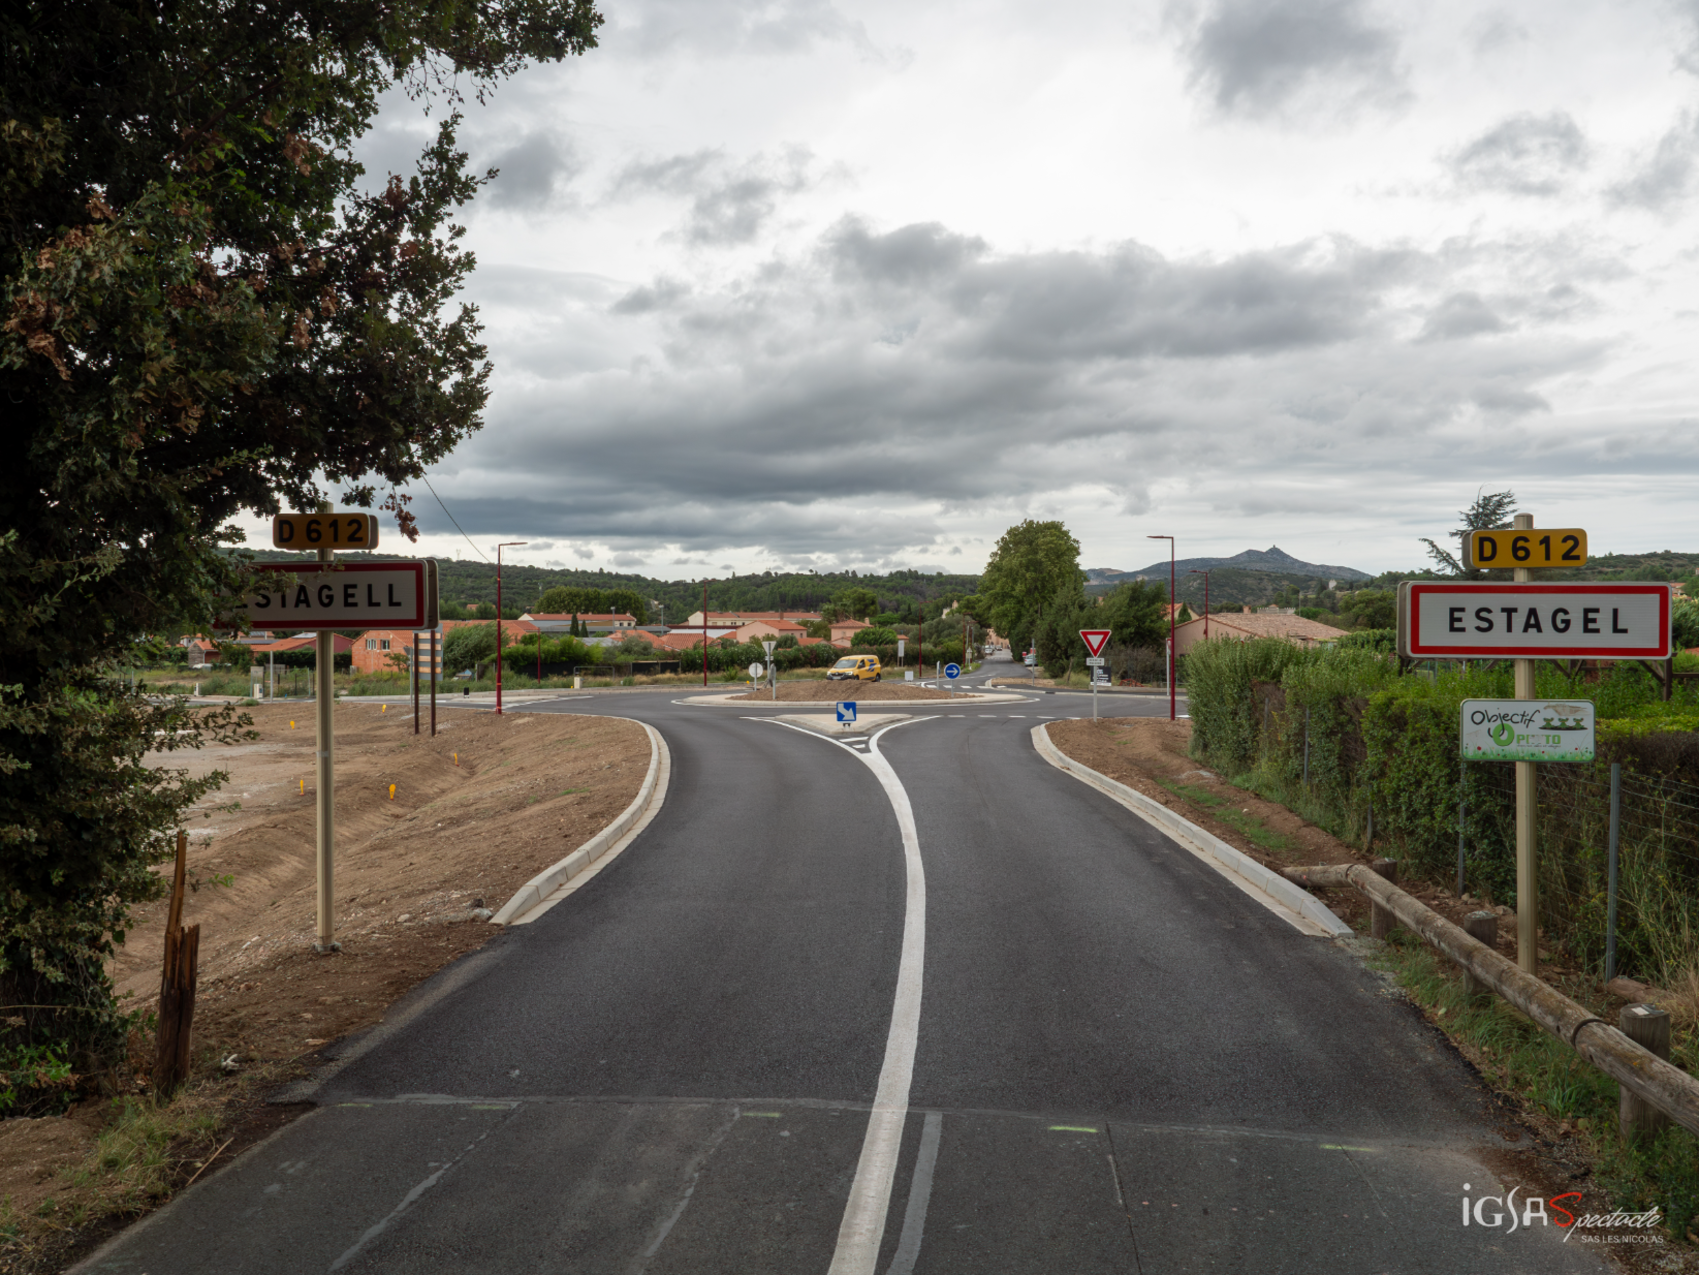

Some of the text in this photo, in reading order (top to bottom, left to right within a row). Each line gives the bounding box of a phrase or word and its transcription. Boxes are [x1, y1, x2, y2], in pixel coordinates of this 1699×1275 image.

[278, 519, 364, 543] D 612
[1478, 535, 1581, 562] D 612
[235, 583, 402, 609] SAGELL
[1448, 606, 1629, 634] ESTAGEL
[1470, 707, 1541, 738] Objectif
[1516, 734, 1562, 745] PTO
